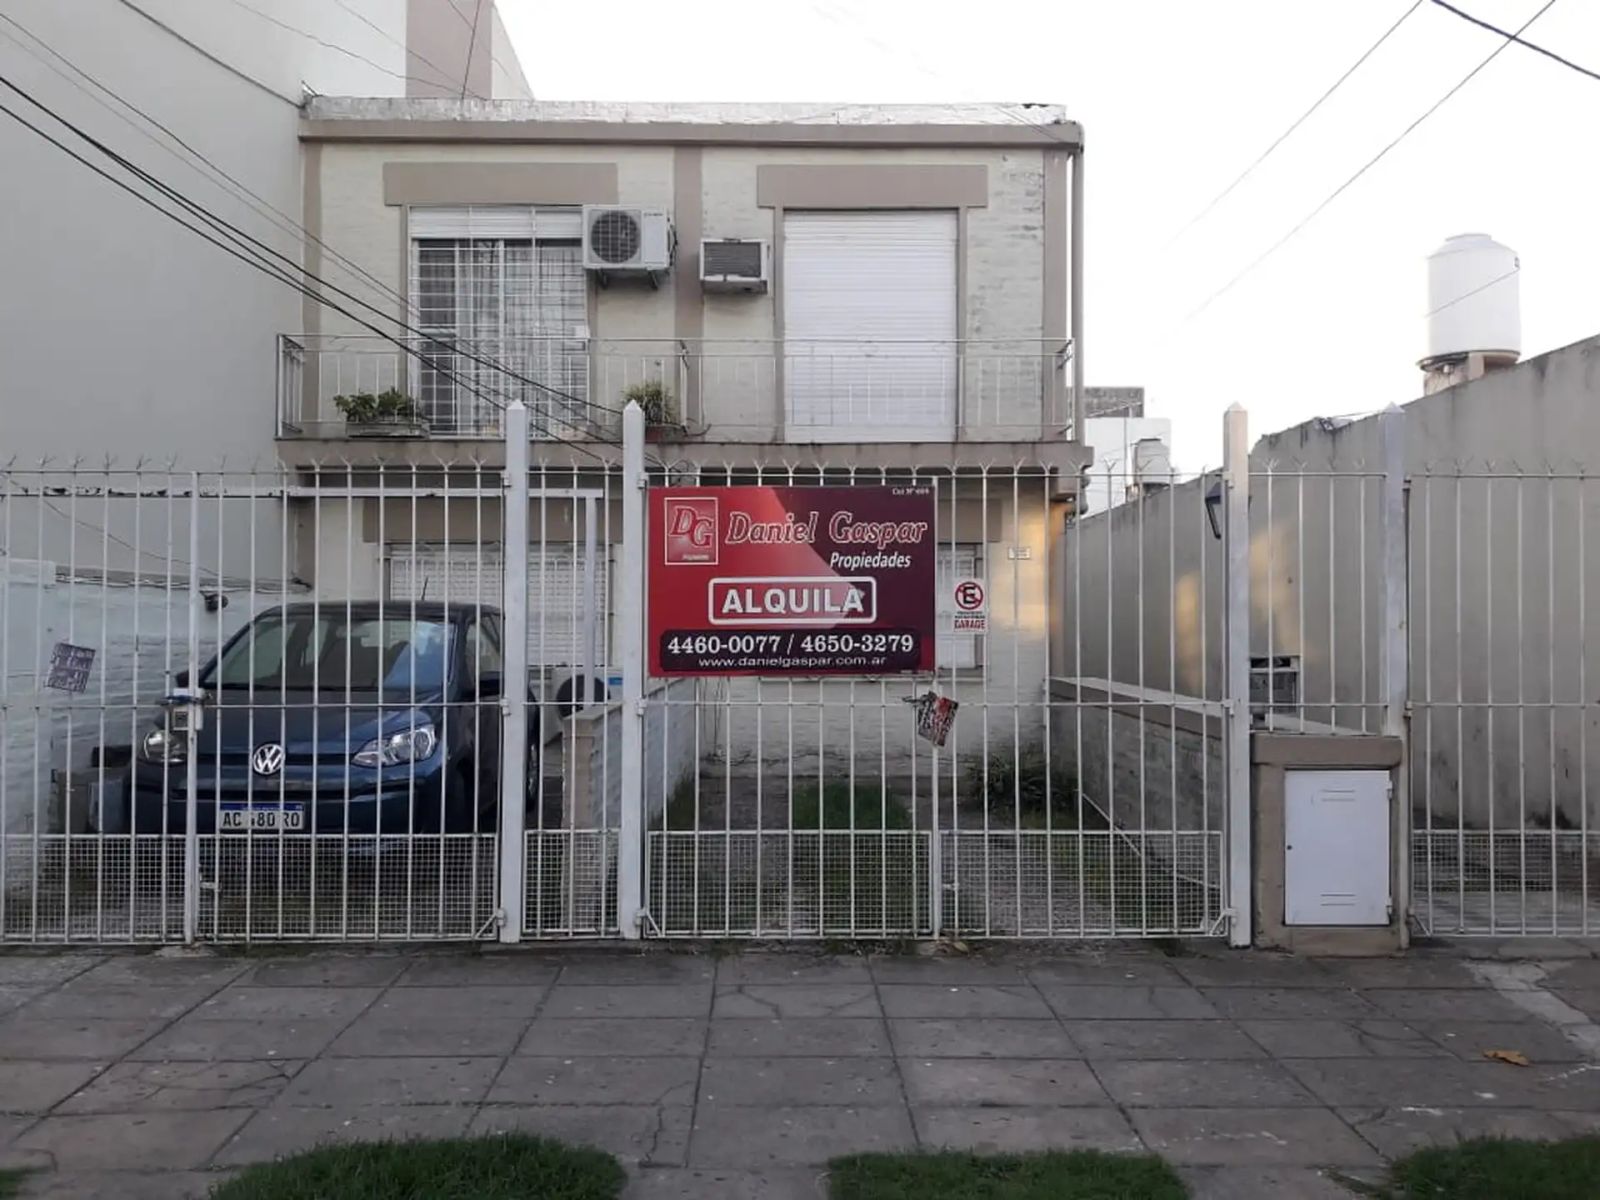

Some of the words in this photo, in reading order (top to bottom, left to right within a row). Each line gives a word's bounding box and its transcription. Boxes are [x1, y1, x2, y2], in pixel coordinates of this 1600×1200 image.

[668, 505, 714, 549] DG
[725, 511, 819, 544] Daniel
[829, 511, 927, 550] Gaspar
[830, 551, 911, 570] Propiedades
[722, 588, 864, 614] ALQUILA
[668, 635, 780, 654] 4460-0077
[801, 634, 913, 653] 4650-3279
[699, 656, 887, 668] www.danielgaspar.com.ar
[223, 812, 242, 827] AC
